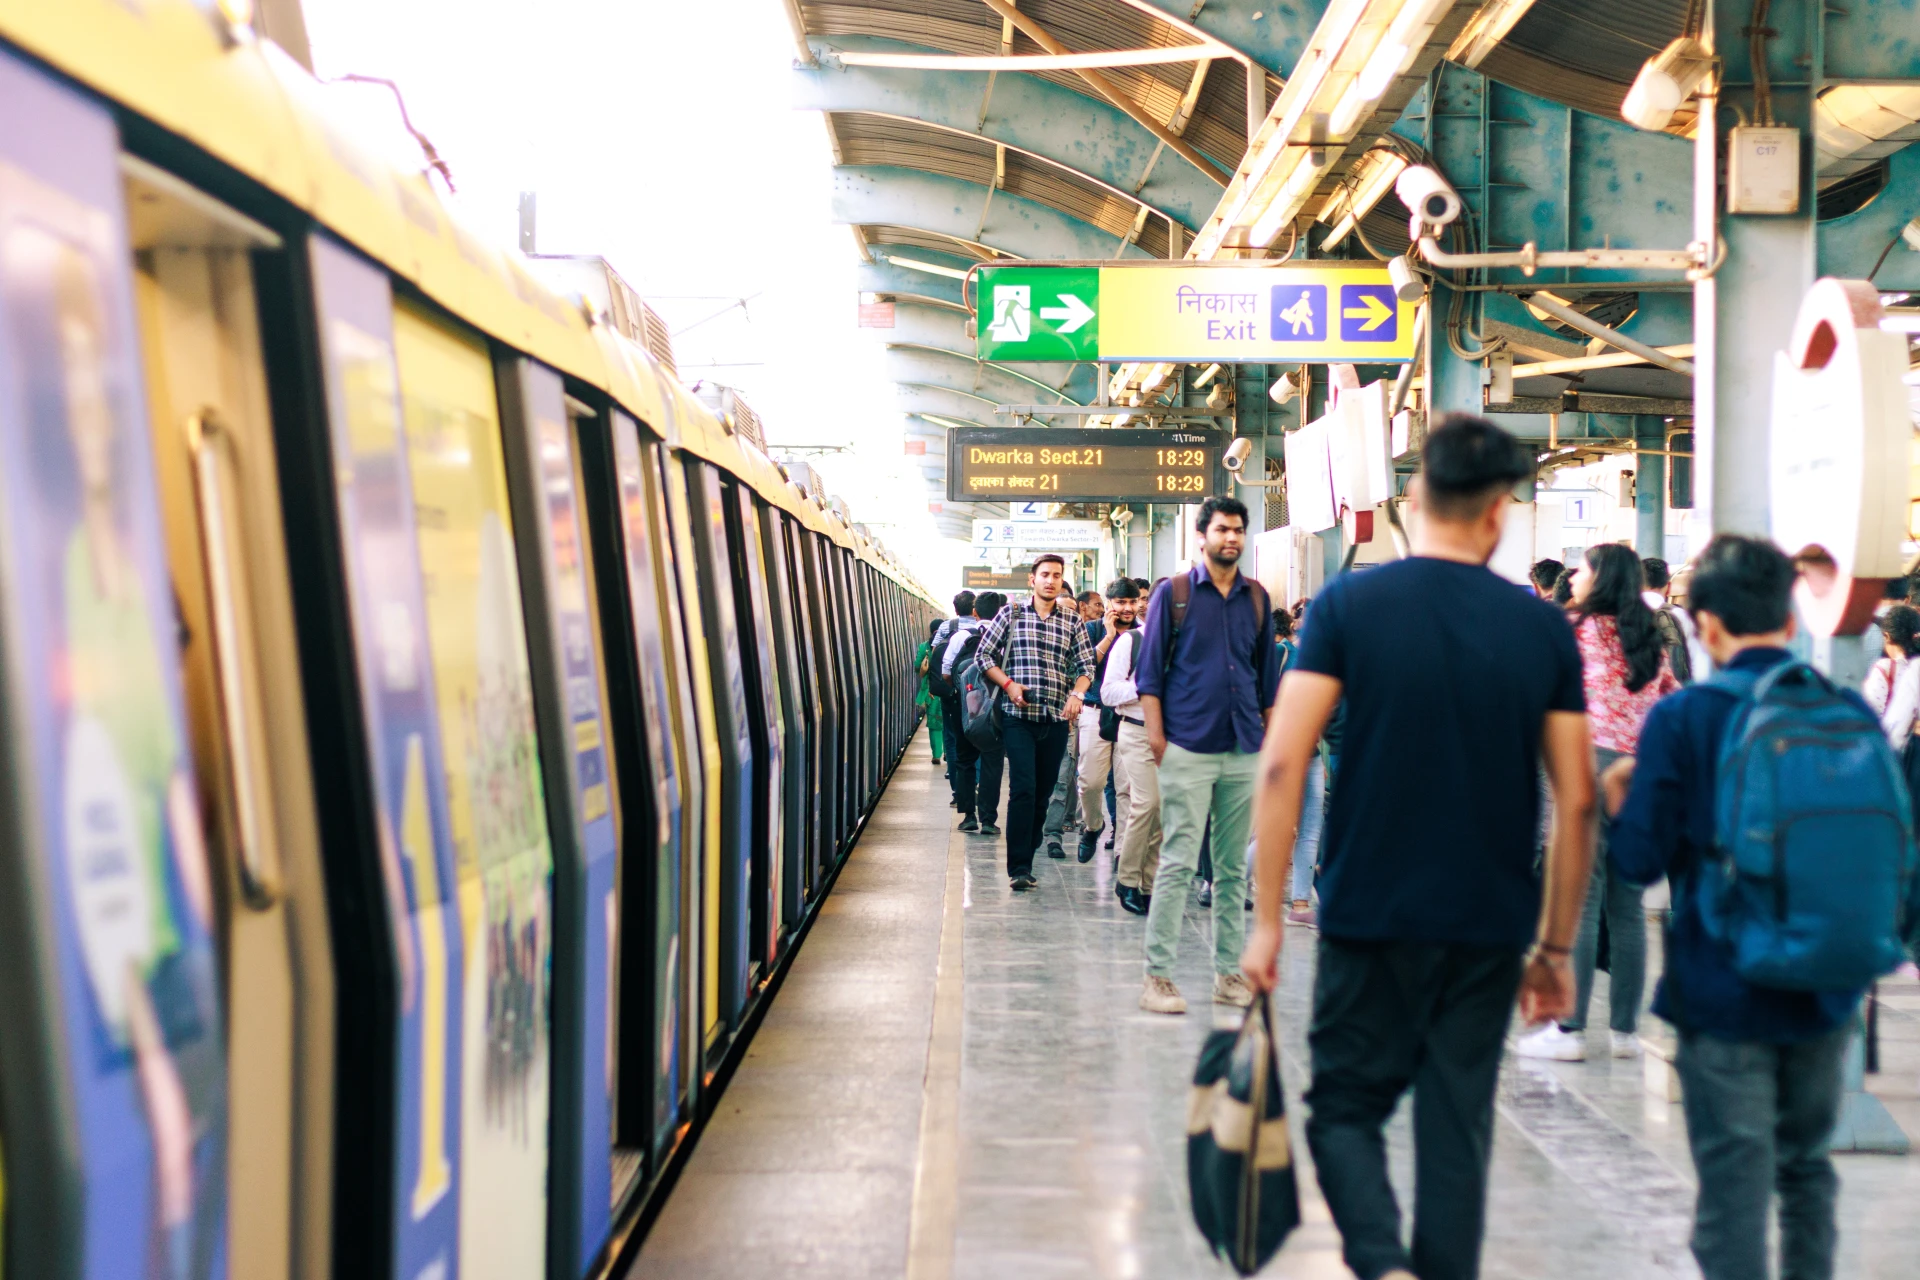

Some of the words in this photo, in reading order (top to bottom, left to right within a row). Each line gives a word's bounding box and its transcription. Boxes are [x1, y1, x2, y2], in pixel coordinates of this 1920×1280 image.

[1756, 146, 1777, 155] C17
[1176, 285, 1258, 313] निकास
[1207, 319, 1256, 340] Exit
[970, 448, 1034, 465] Dwarka
[1040, 448, 1102, 465] Sect.21
[1157, 450, 1204, 466] 18:29
[1040, 474, 1058, 490] 21
[1157, 475, 1204, 491] 18:29
[1574, 500, 1583, 519] 1
[983, 526, 993, 541] 2
